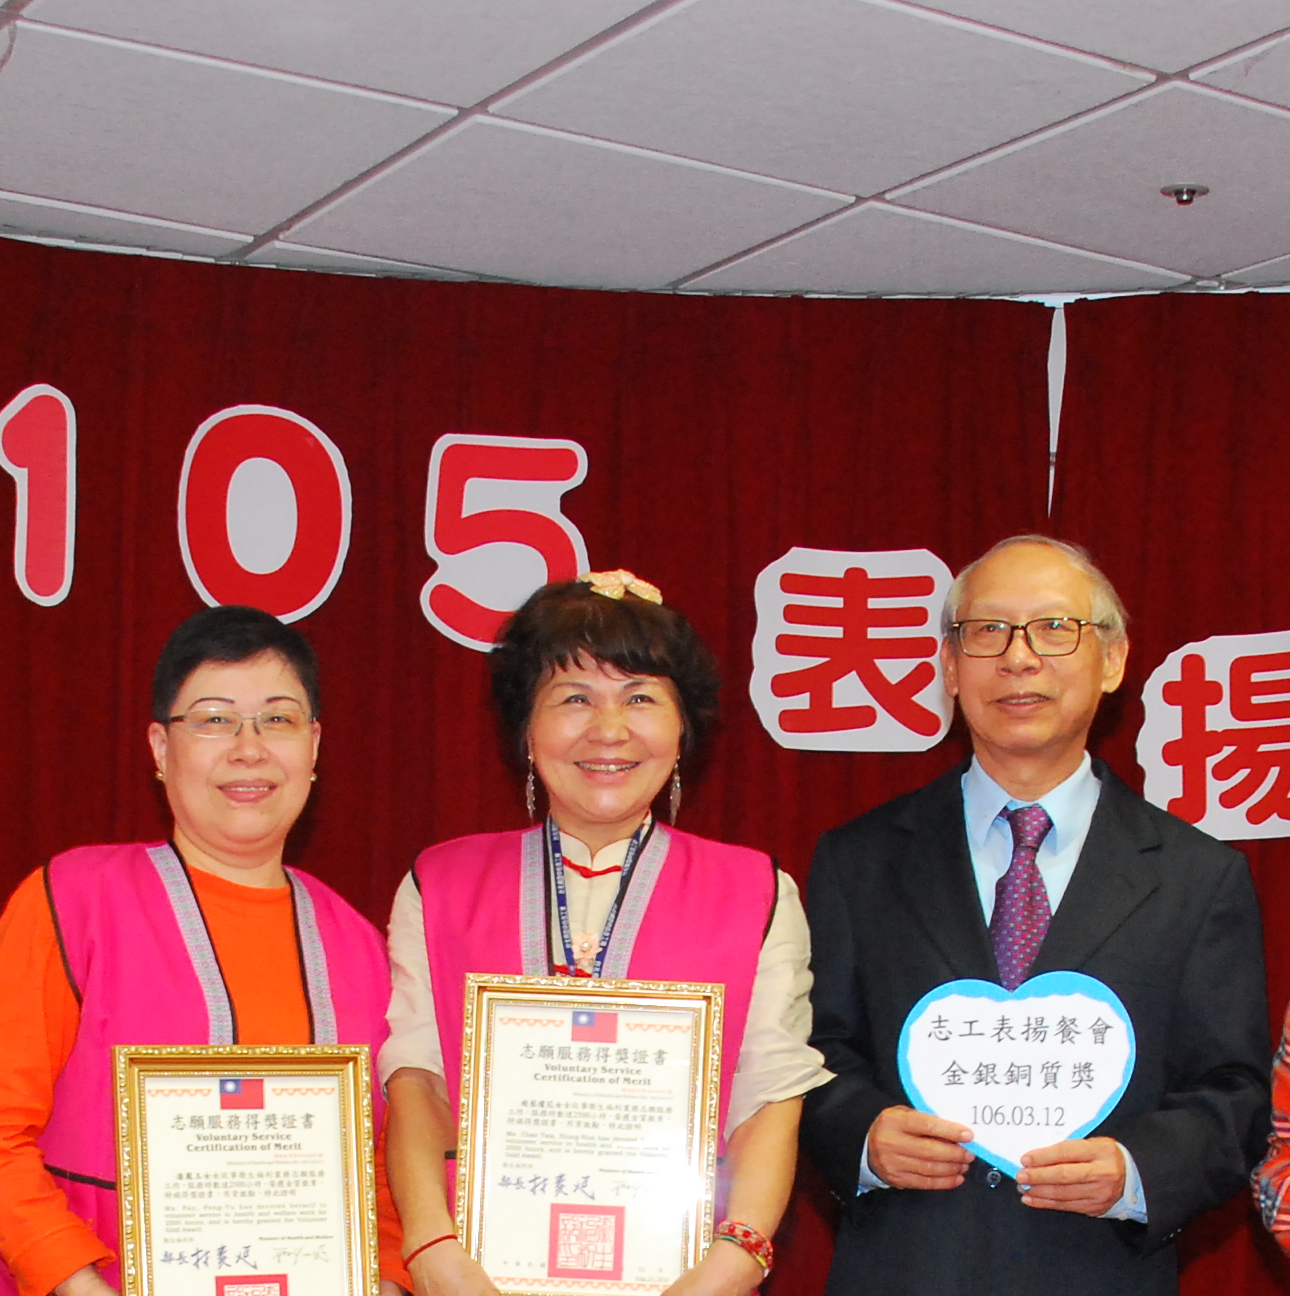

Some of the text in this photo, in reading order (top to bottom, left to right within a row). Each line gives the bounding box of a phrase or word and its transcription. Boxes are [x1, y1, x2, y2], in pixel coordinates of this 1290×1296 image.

[927, 1014, 1115, 1046] 志工表揚餐會
[520, 1043, 668, 1066] 志願服務得獎證書
[544, 1063, 642, 1076] Voluntary Service
[941, 1060, 1096, 1089] 金銀銅質獎
[534, 1073, 651, 1086] Certification of Merit
[171, 1112, 316, 1130] 志願服務得獎證書
[971, 1104, 1066, 1127] 106.03.12
[196, 1132, 292, 1143] Voluntary Service
[187, 1142, 302, 1152] Certification of Merit
